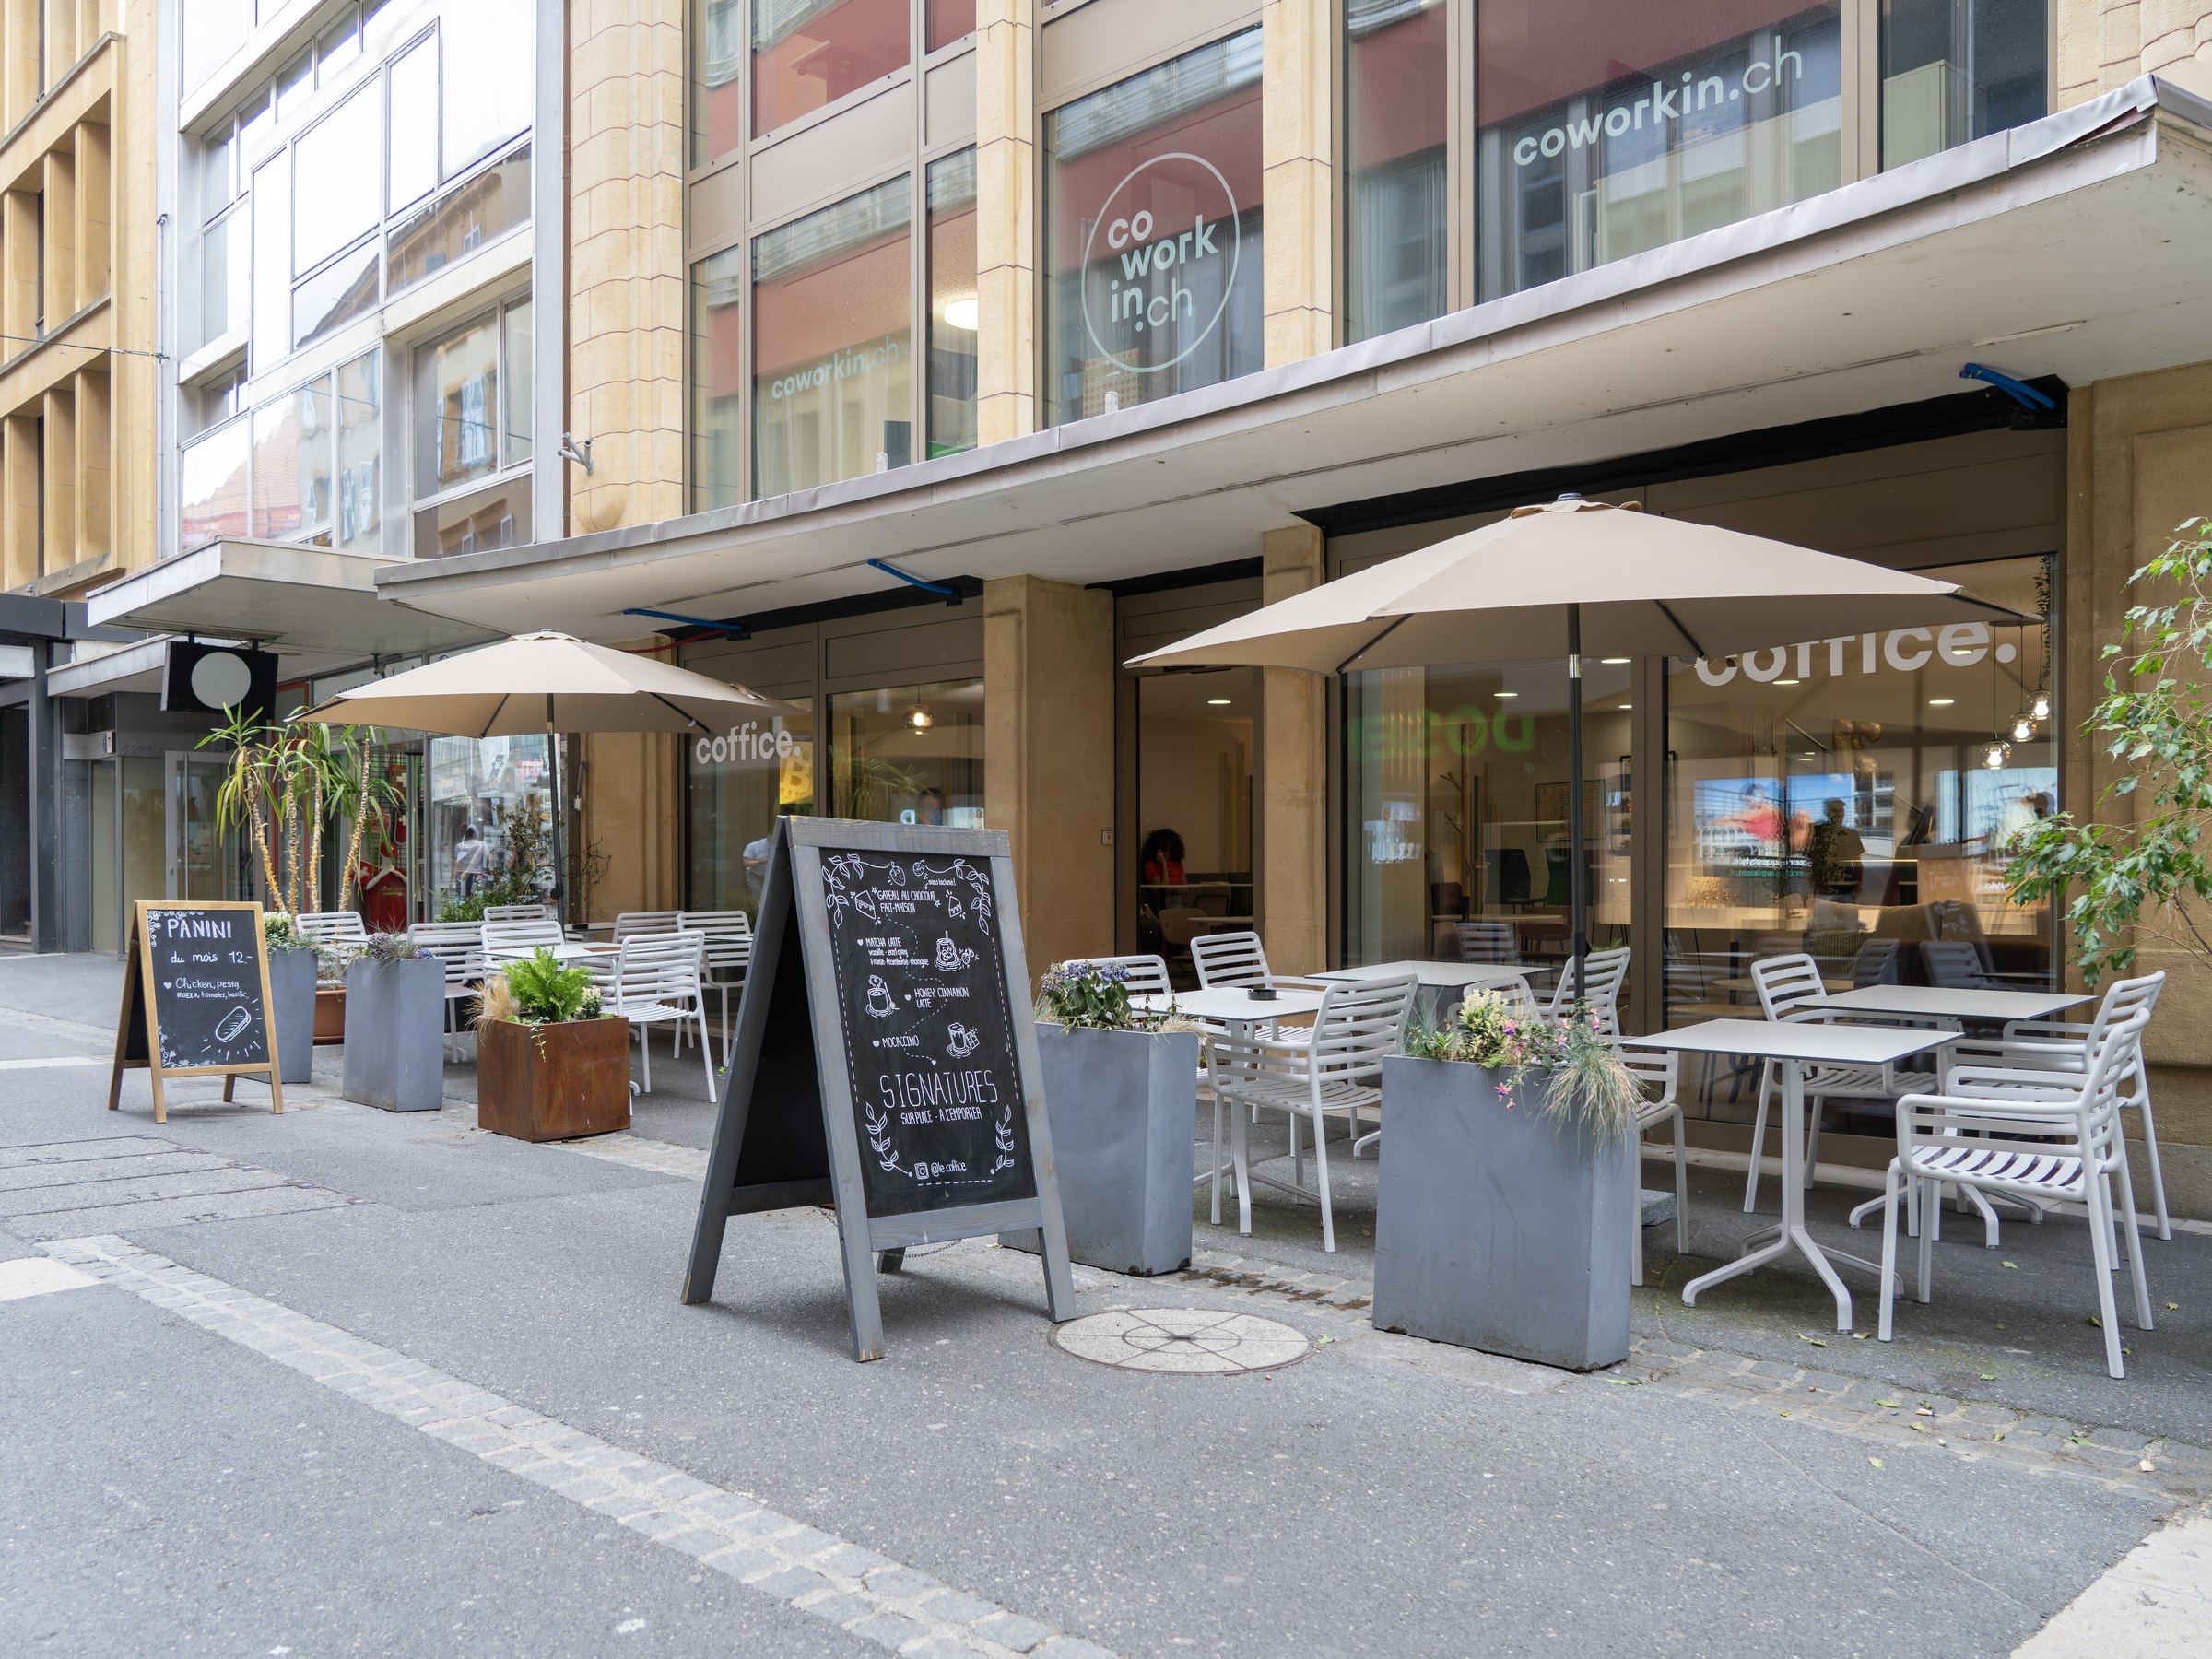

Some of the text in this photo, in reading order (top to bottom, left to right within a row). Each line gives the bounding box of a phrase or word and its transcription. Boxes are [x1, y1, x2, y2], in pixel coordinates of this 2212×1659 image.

[1513, 35, 1802, 166] coworkin.ch
[1107, 210, 1153, 249] co
[1120, 214, 1218, 281] work
[1111, 277, 1193, 332] in.ch
[771, 335, 899, 399] coworkin.ch
[696, 722, 802, 764] coffice.
[877, 890, 936, 901] GATEAU AU CHOCOLAT
[880, 902, 916, 913] FAIT-MAISON
[167, 918, 232, 939] PANINI
[865, 936, 902, 947] MATCHA LATTE
[171, 951, 185, 964] du
[192, 952, 218, 963] mois
[868, 947, 885, 956] vanille
[913, 986, 970, 998] HONEY CINNAMON
[916, 999, 932, 1008] LATTE
[882, 1034, 920, 1048] MOCACCINO
[879, 1069, 998, 1109] SIGNATURES
